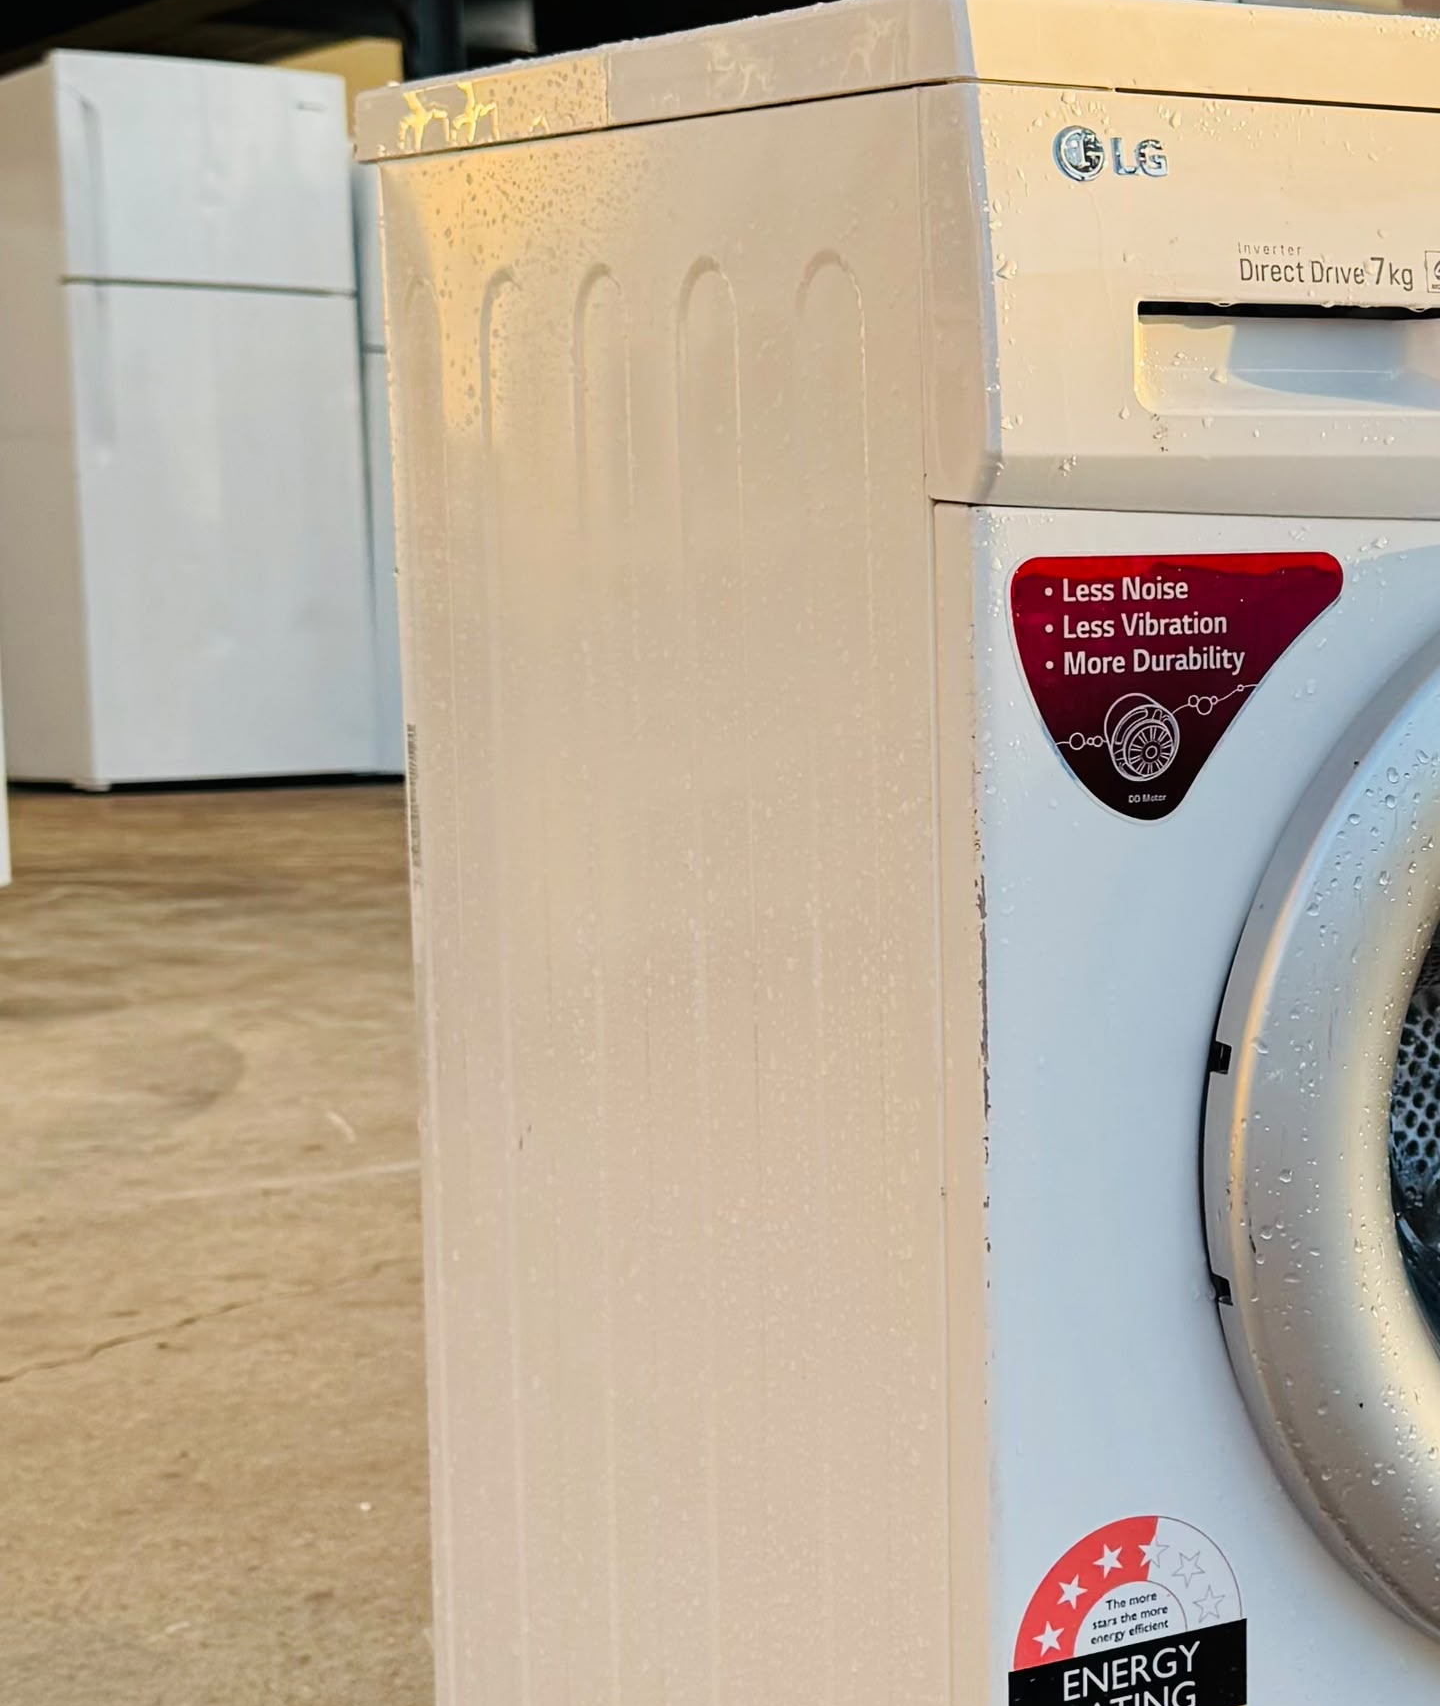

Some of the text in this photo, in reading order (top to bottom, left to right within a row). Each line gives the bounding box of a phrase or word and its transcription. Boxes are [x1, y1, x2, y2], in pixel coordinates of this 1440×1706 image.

[1110, 137, 1168, 177] LG
[1237, 242, 1303, 256] Inverter
[1239, 258, 1304, 284] Direct
[1310, 260, 1365, 286] Drive
[1062, 575, 1188, 602] Less Noise
[1062, 611, 1228, 639] Less Vibration
[1063, 645, 1246, 676] More Durability
[1128, 793, 1167, 804] DD Motor
[1106, 1592, 1158, 1611] The more
[1092, 1605, 1169, 1630] stars the more
[1090, 1619, 1170, 1646] energy efficient
[1062, 1640, 1201, 1702] ENERGY
